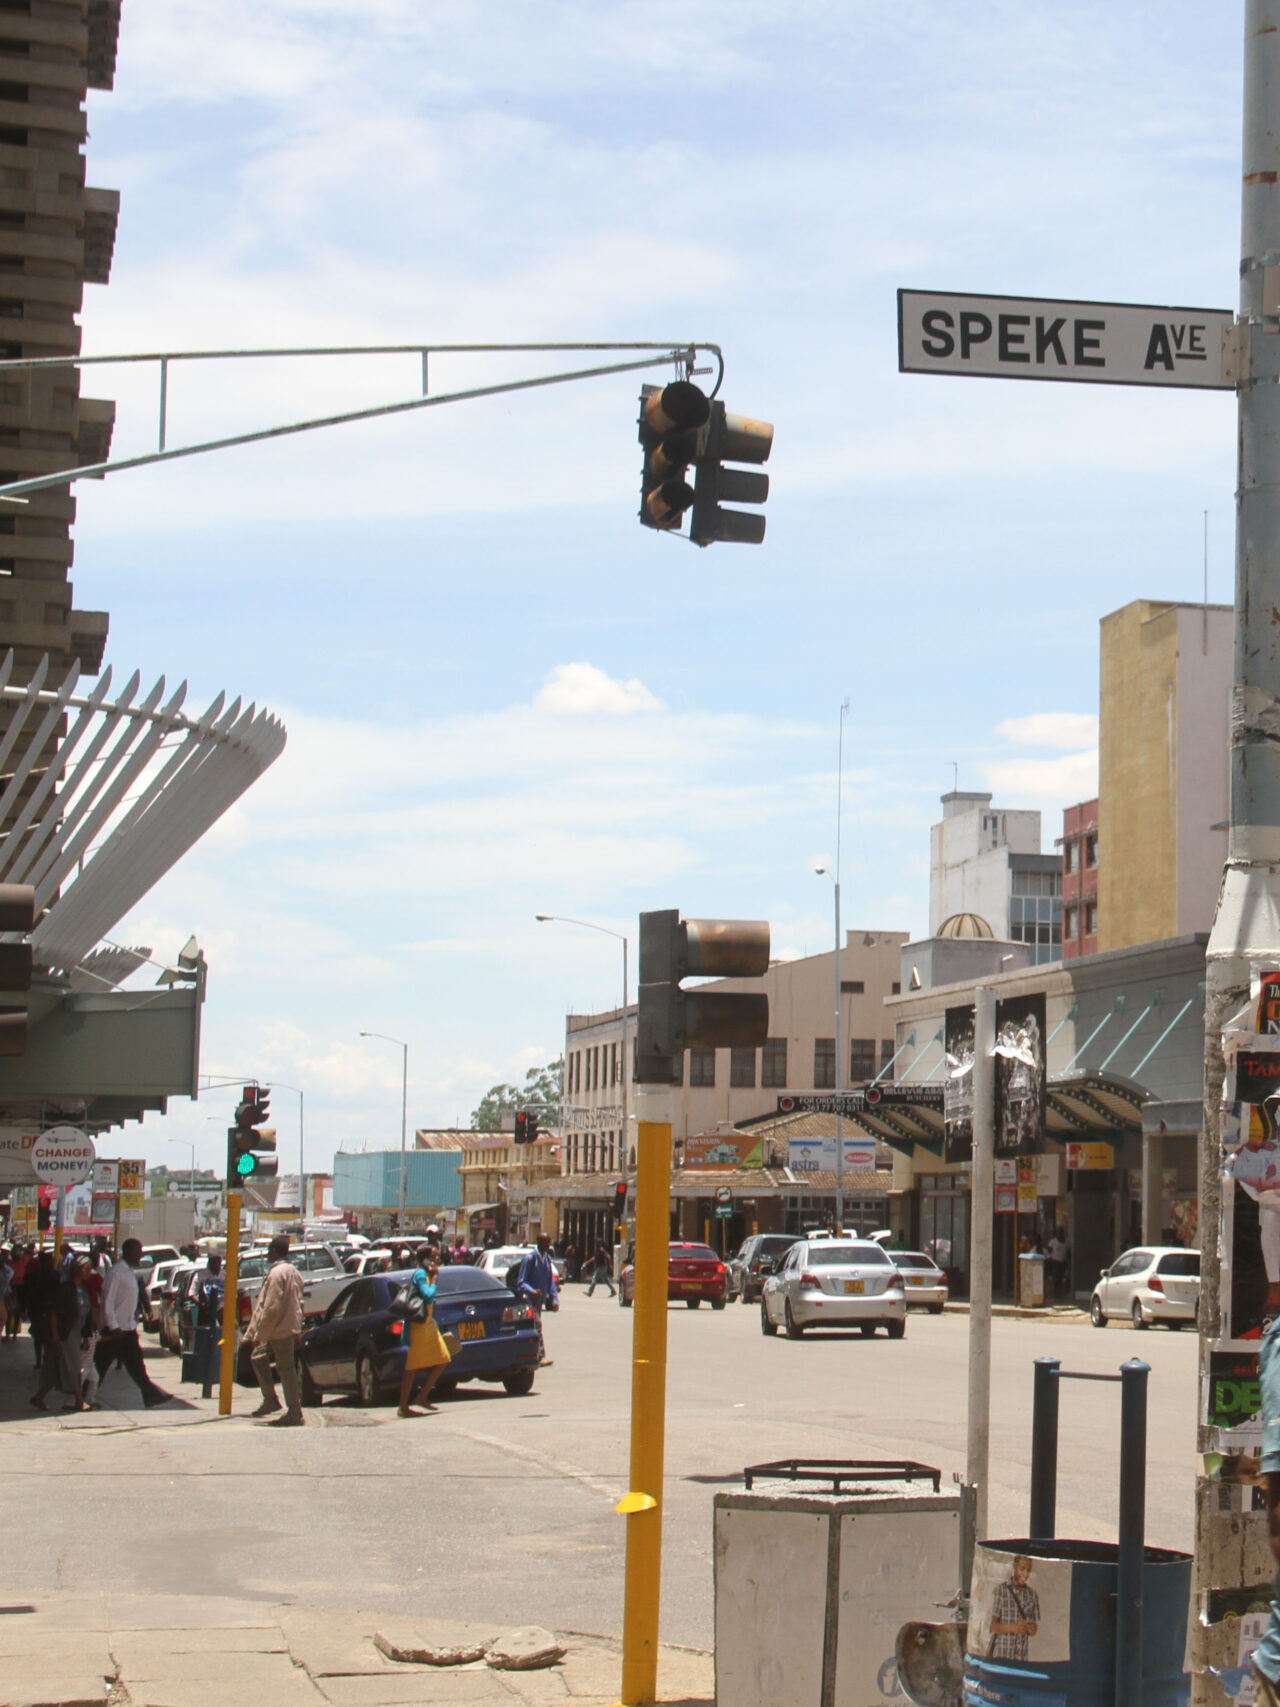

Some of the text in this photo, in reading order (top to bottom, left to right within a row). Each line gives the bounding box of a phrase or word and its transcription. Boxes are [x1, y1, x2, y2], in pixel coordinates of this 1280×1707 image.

[921, 310, 1106, 367] SPEKE
[799, 1097, 815, 1106] FOR
[816, 1096, 846, 1105] ORDERS
[791, 1158, 819, 1171] astra
